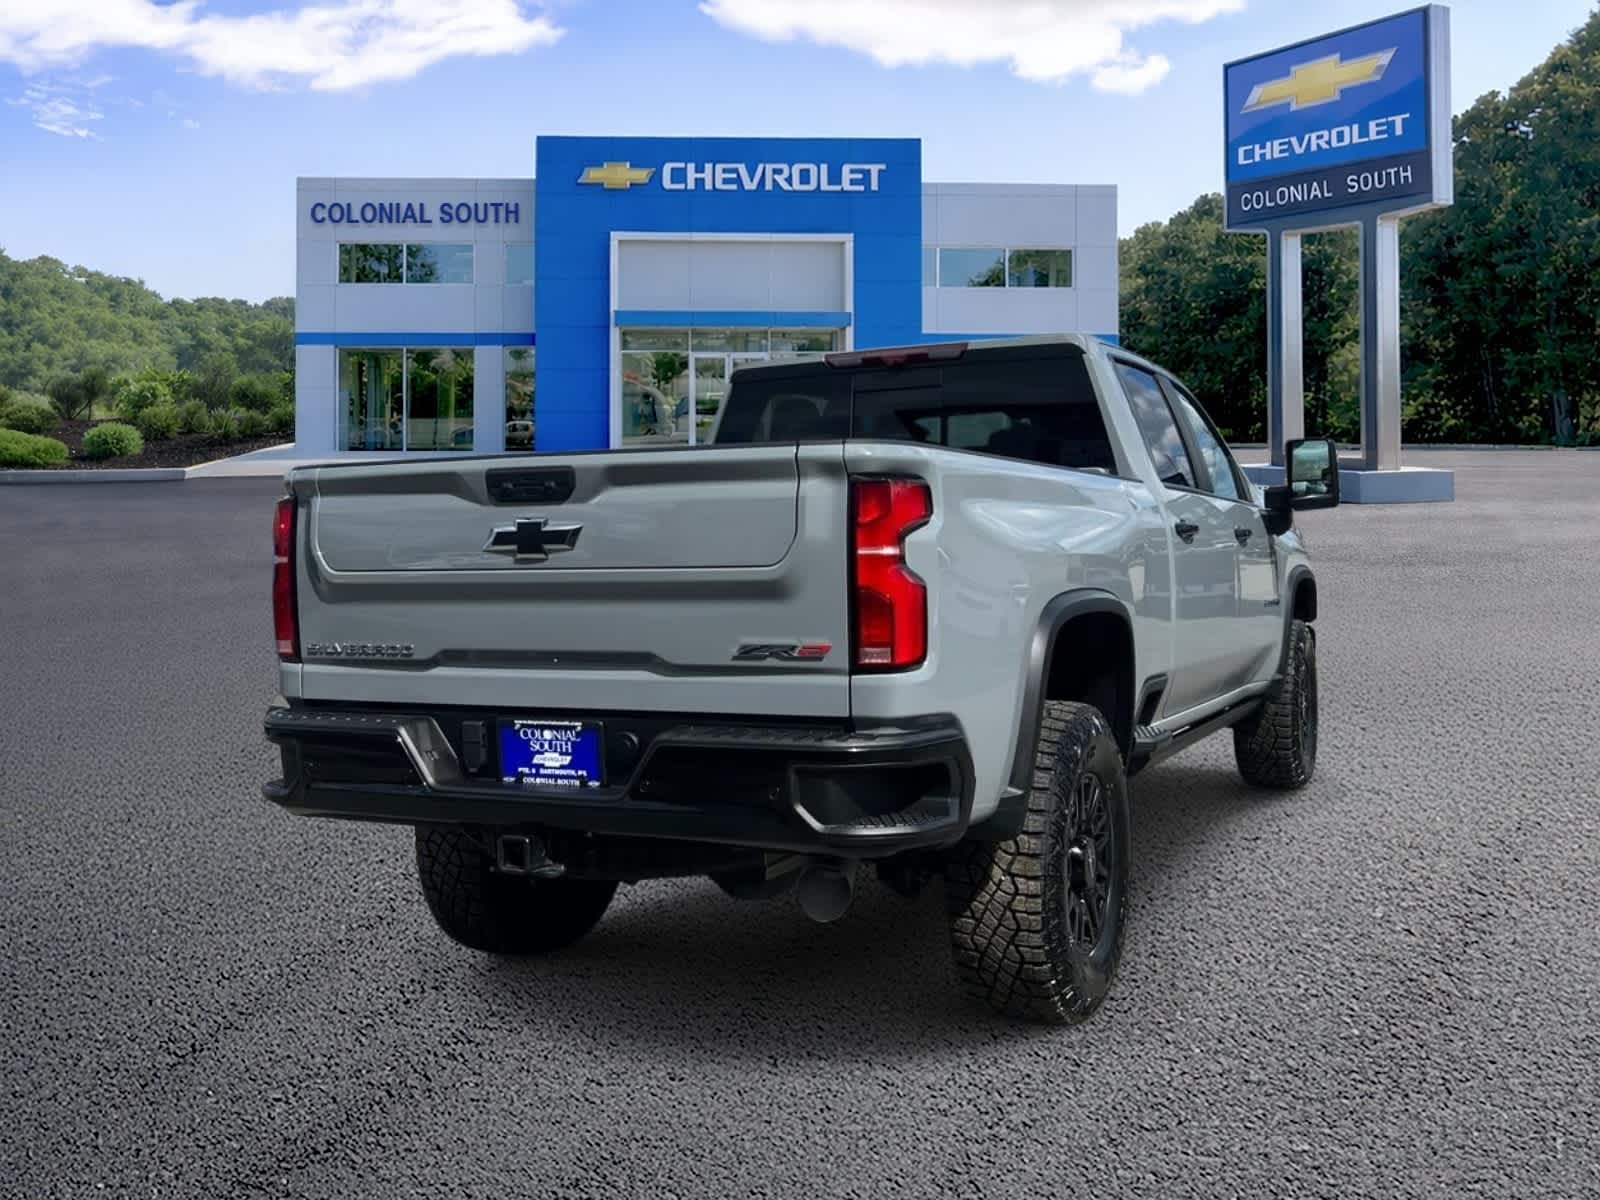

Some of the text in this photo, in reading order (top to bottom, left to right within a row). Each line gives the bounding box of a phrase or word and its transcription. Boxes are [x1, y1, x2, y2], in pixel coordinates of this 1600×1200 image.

[1237, 113, 1410, 165] CHEVROLET
[662, 162, 886, 192] CHEVROLET
[1241, 165, 1412, 211] COLONIAL SOUTH
[310, 202, 520, 224] COLONIAL SOUTH
[307, 642, 415, 658] SILVERADO
[520, 728, 581, 741] COLONIAL
[530, 740, 572, 752] SOUTH
